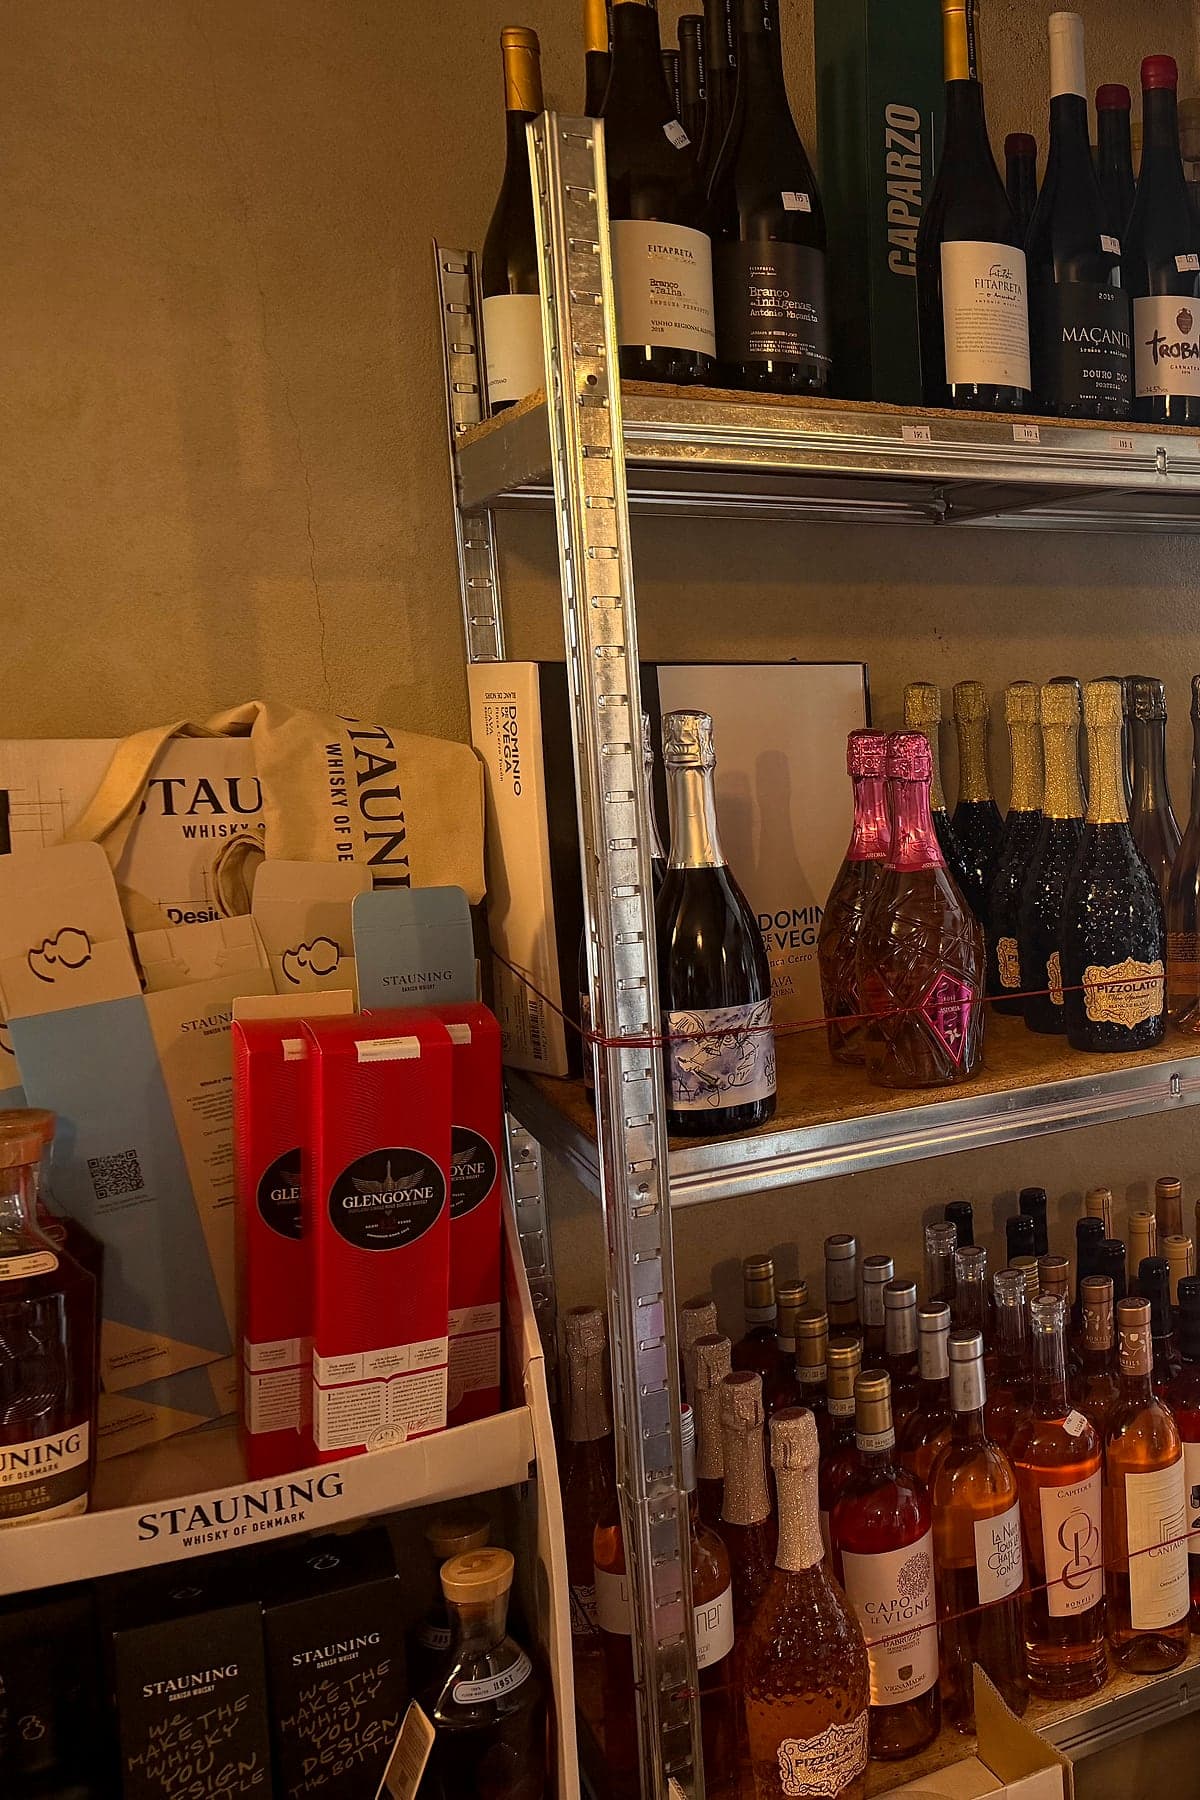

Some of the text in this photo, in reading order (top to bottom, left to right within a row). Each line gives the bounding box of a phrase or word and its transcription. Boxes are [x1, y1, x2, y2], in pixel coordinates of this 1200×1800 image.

[885, 103, 922, 277] CAPARZO
[648, 244, 694, 258] FITAPRETA
[649, 278, 679, 289] Branco
[749, 286, 790, 298] Branco
[974, 278, 1022, 295] FITAPRETA
[1083, 370, 1112, 379] DOURO
[502, 721, 512, 773] VEGA
[509, 706, 521, 796] DOMINIO
[325, 743, 348, 807] WHISKY
[138, 777, 264, 815] TAU
[336, 714, 411, 890] TAUNI
[333, 815, 351, 834] OF
[774, 927, 818, 951] VEG
[788, 954, 813, 964] Cerro
[382, 970, 453, 987] STAUNING
[1097, 980, 1158, 993] PIZZOLATO
[342, 1187, 434, 1209] GLENGOYNE
[17, 1463, 59, 1480] DENMARK
[138, 1472, 345, 1541] STAUNING
[182, 1511, 306, 1547] WHISKY OF DENMARK
[865, 1596, 910, 1614] CAPO
[292, 1632, 381, 1667] STAUNING
[143, 1664, 239, 1698] STAUNING
[281, 1659, 391, 1732] MAKE THE
[128, 1694, 250, 1772] MAKE THE
[302, 1712, 399, 1776] DESIGN
[312, 1711, 360, 1748] YOU
[161, 1752, 214, 1792] YOU
